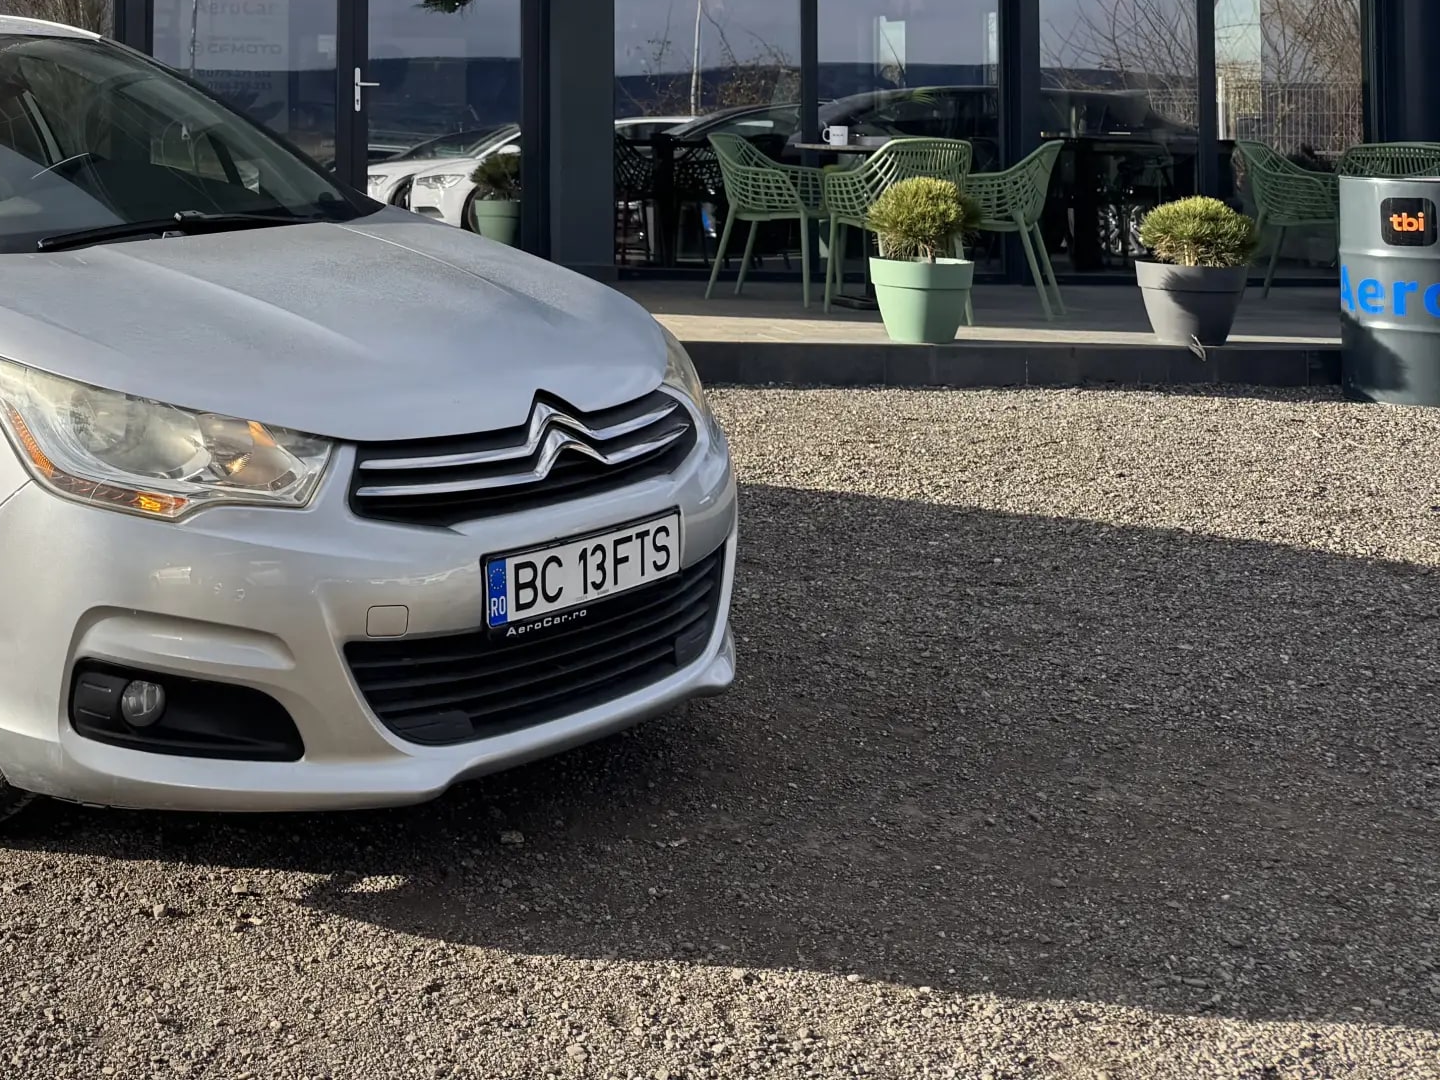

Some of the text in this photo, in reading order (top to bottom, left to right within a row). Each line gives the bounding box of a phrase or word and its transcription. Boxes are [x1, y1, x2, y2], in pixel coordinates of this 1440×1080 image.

[197, 0, 274, 16] AeroCar
[207, 43, 282, 55] CFMOTO
[1389, 211, 1425, 232] tbi
[514, 525, 671, 612] BC 13FTS
[490, 595, 507, 618] RO
[506, 608, 588, 637] AeroCar.ro
